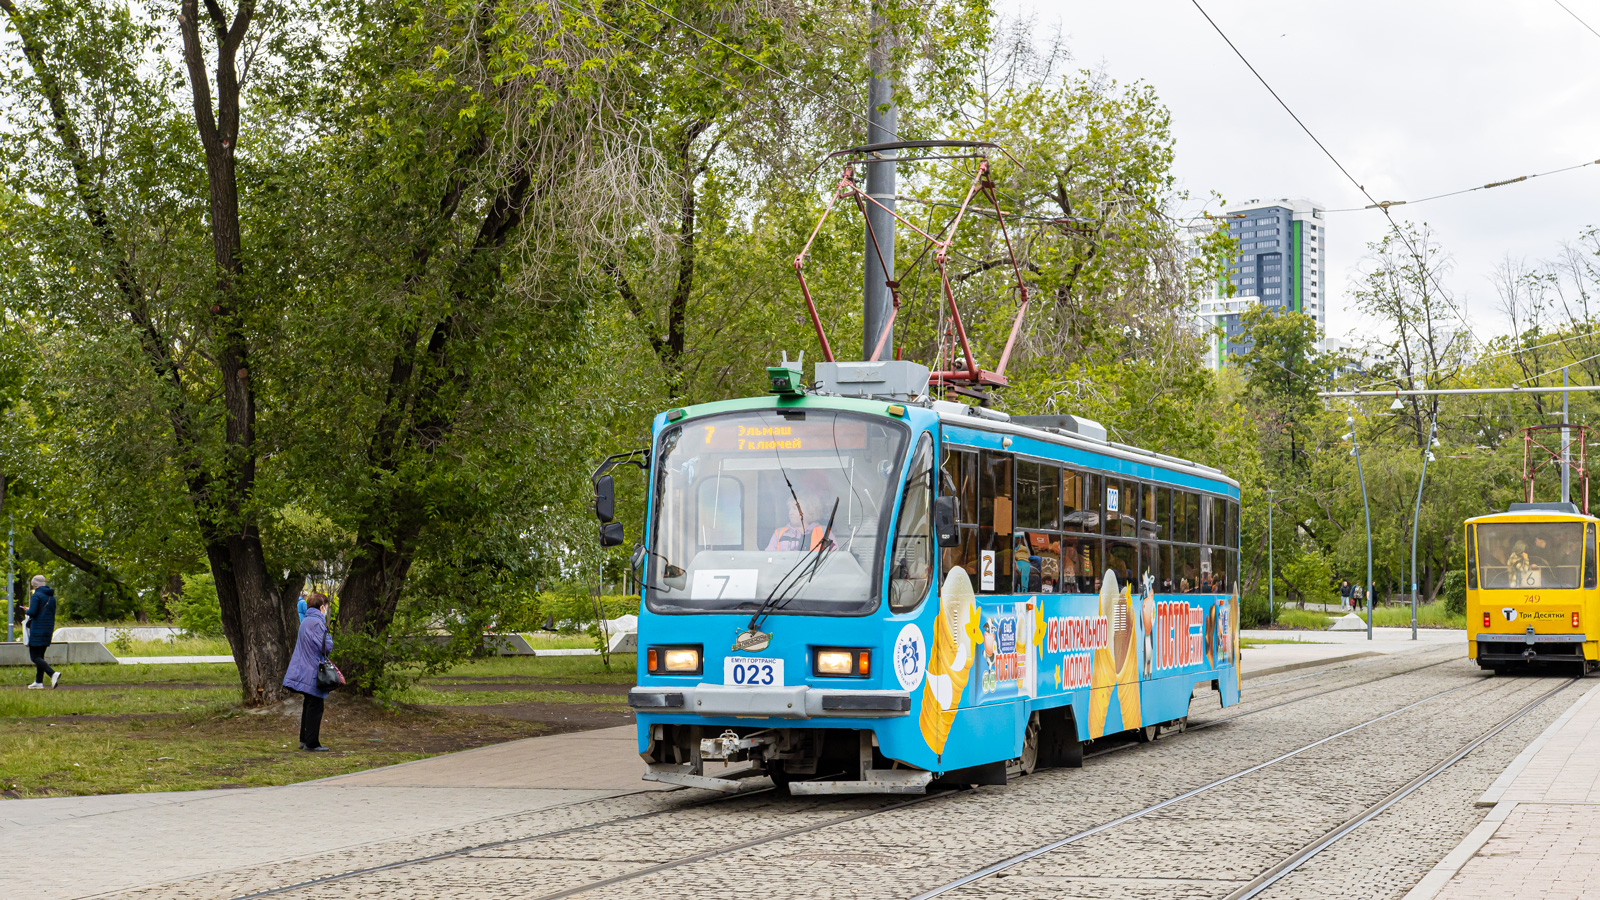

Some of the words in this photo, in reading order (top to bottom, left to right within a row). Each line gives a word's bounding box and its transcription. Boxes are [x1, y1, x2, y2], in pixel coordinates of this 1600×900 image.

[704, 426, 715, 444] 7
[738, 425, 792, 436] Эльмаш
[738, 439, 746, 450] 7
[748, 438, 802, 449] ключей
[1526, 572, 1536, 586] 6
[713, 575, 731, 600] 7
[1523, 594, 1541, 604] 749
[1519, 611, 1532, 619] Три
[1534, 611, 1565, 619] Десятки
[1048, 617, 1058, 653] ИЗ
[1059, 615, 1108, 652] НАТУРАЛЬНОГО
[733, 664, 774, 685] 023
[1063, 653, 1092, 690] МОЛОКА
